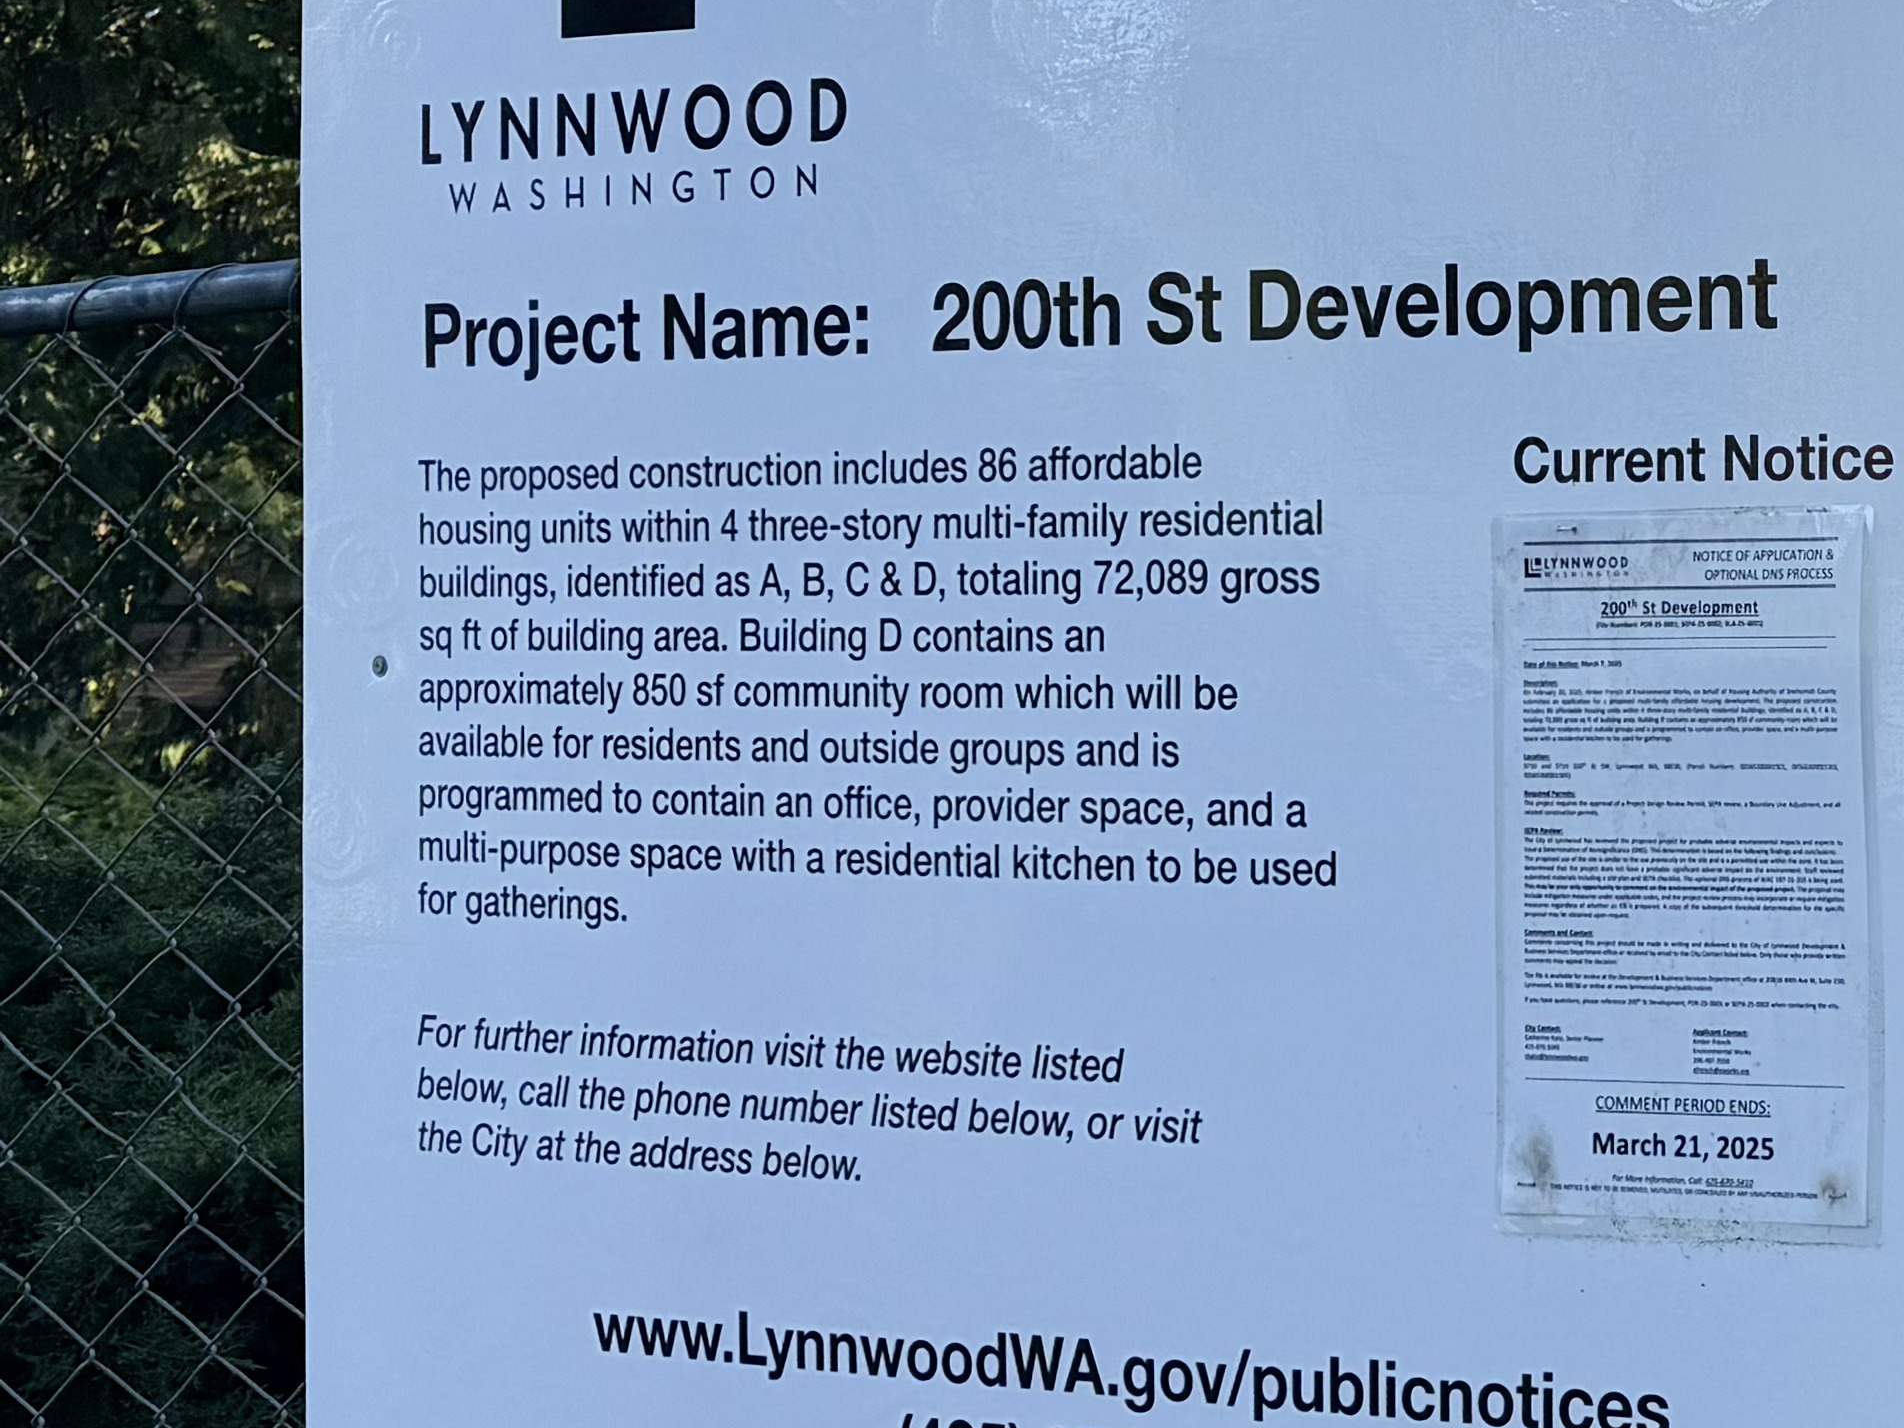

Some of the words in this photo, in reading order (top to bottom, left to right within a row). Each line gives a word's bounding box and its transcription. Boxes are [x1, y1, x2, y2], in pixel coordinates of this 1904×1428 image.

[421, 77, 848, 166] LYNNWOOD
[448, 162, 817, 215] WASHINGTON
[424, 298, 641, 382] Project
[663, 292, 869, 361] Name:
[931, 275, 1121, 352] 200th
[1146, 271, 1223, 346] St
[1249, 258, 1778, 353] Development
[417, 458, 471, 493] The
[480, 455, 619, 501] proposed
[628, 451, 822, 490] construction
[833, 448, 968, 486] includes
[977, 446, 1017, 483] 86
[1027, 442, 1203, 483] affordable
[1513, 435, 1706, 486] Current
[1724, 433, 1895, 482] Notice
[419, 510, 531, 554] housing
[541, 509, 612, 545] units
[620, 508, 710, 544] within
[720, 508, 739, 543] 4
[747, 507, 923, 550] three-story
[933, 501, 1129, 548] multi-family
[1139, 498, 1323, 538] residential
[1544, 556, 1629, 569] LYNNWOOD
[1692, 550, 1733, 562] NOTICE
[1735, 550, 1749, 561] OF
[1752, 549, 1823, 561] APPLICATION
[1826, 548, 1834, 560] &
[1705, 569, 1759, 581] OPTIONAL
[1762, 568, 1784, 580] DNS
[1787, 568, 1834, 580] PROCESS
[419, 564, 557, 607] buildings,
[567, 562, 705, 598] identified
[714, 571, 751, 598] as
[758, 562, 791, 604] A,
[802, 561, 834, 604] B,
[845, 561, 870, 598] C
[879, 560, 904, 597] &
[913, 561, 946, 603] D,
[956, 559, 1082, 605] totaling
[1093, 558, 1209, 602] 72,089
[1220, 566, 1321, 605] gross
[1600, 598, 1638, 615] 200th
[1642, 600, 1657, 615] St
[1661, 599, 1759, 616] Development
[419, 625, 453, 660] sq
[460, 617, 483, 652] ft
[490, 617, 520, 652] of
[527, 617, 644, 661] building
[653, 625, 728, 653] area.
[739, 617, 867, 662] Building
[879, 617, 903, 653] D
[912, 616, 1054, 653] contains
[1064, 625, 1105, 653] an
[418, 670, 624, 715] approximately
[632, 672, 687, 707] 850
[695, 672, 726, 707] sf
[733, 673, 910, 718] community
[920, 681, 1004, 710] room
[1014, 673, 1114, 710] which
[1125, 673, 1181, 710] will
[1194, 674, 1239, 711] be
[418, 723, 544, 759] available
[551, 725, 595, 760] for
[602, 726, 742, 763] residents
[751, 728, 809, 764] and
[819, 729, 940, 765] outside
[949, 738, 1066, 776] groups
[1075, 731, 1139, 768] and
[1152, 731, 1180, 769] is
[418, 779, 603, 819] programmed
[611, 781, 643, 815] to
[651, 782, 765, 818] contain
[775, 791, 813, 819] an
[823, 784, 921, 828] office,
[932, 786, 1071, 830] provider
[1079, 796, 1194, 834] space,
[1206, 790, 1273, 828] and
[1285, 799, 1308, 829] a
[418, 829, 621, 875] multi-purpose
[629, 842, 723, 878] space
[731, 837, 796, 873] with
[805, 847, 826, 875] a
[835, 840, 1001, 879] residential
[1012, 843, 1135, 882] kitchen
[1145, 848, 1182, 884] to
[1193, 847, 1238, 885] be
[1249, 850, 1337, 888] used
[417, 881, 458, 916] for
[465, 884, 628, 930] gatherings.
[417, 1013, 467, 1049] For
[473, 1017, 574, 1055] further
[579, 1022, 754, 1065] information
[764, 1032, 827, 1069] visit
[834, 1035, 886, 1073] the
[895, 1040, 1022, 1079] website
[1031, 1043, 1126, 1084] listed
[416, 1066, 508, 1111] below,
[518, 1074, 571, 1109] call
[578, 1076, 626, 1113] the
[632, 1080, 731, 1122] phone
[739, 1089, 864, 1126] number
[870, 1092, 960, 1132] listed
[967, 1097, 1074, 1145] below,
[1086, 1112, 1126, 1140] or
[1134, 1106, 1204, 1145] visit
[1595, 1095, 1670, 1112] COMMENT
[1674, 1097, 1726, 1113] PERIOD
[1729, 1099, 1771, 1115] ENDS:
[417, 1119, 463, 1155] the
[471, 1122, 529, 1167] City
[535, 1129, 567, 1162] at
[573, 1130, 621, 1166] the
[629, 1135, 753, 1175] address
[761, 1141, 862, 1182] below.
[1592, 1132, 1666, 1156] March
[1674, 1134, 1709, 1163] 21,
[1717, 1136, 1775, 1160] 2025
